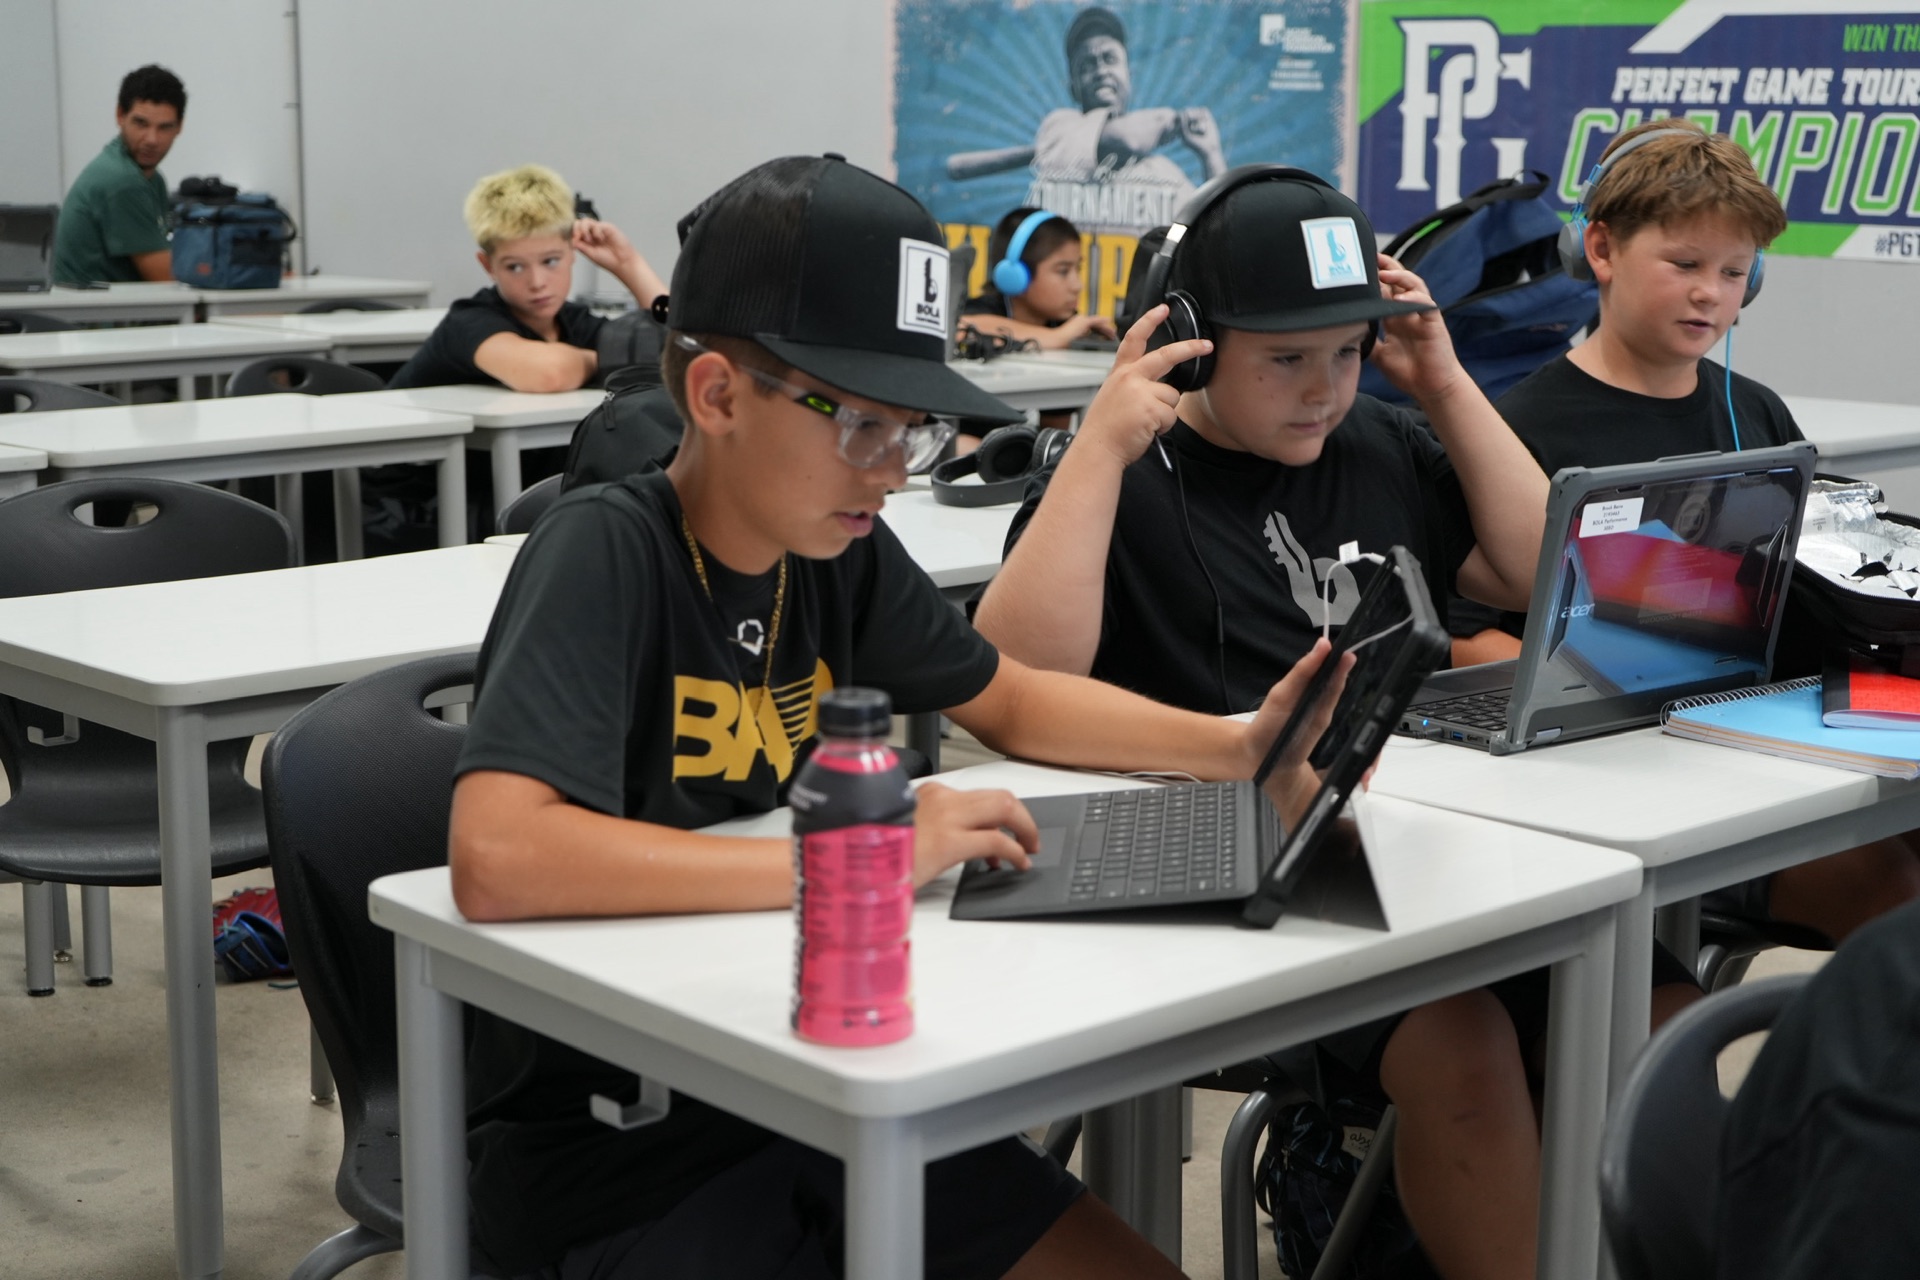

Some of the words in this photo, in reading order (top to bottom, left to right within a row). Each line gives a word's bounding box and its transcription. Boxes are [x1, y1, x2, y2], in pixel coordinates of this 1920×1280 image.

[1843, 23, 1890, 53] WIN
[1892, 24, 1920, 53] TH
[1611, 66, 1741, 104] PERFECT
[1743, 67, 1834, 106] GAME
[916, 303, 940, 318] BOLA
[1561, 603, 1595, 619] acer
